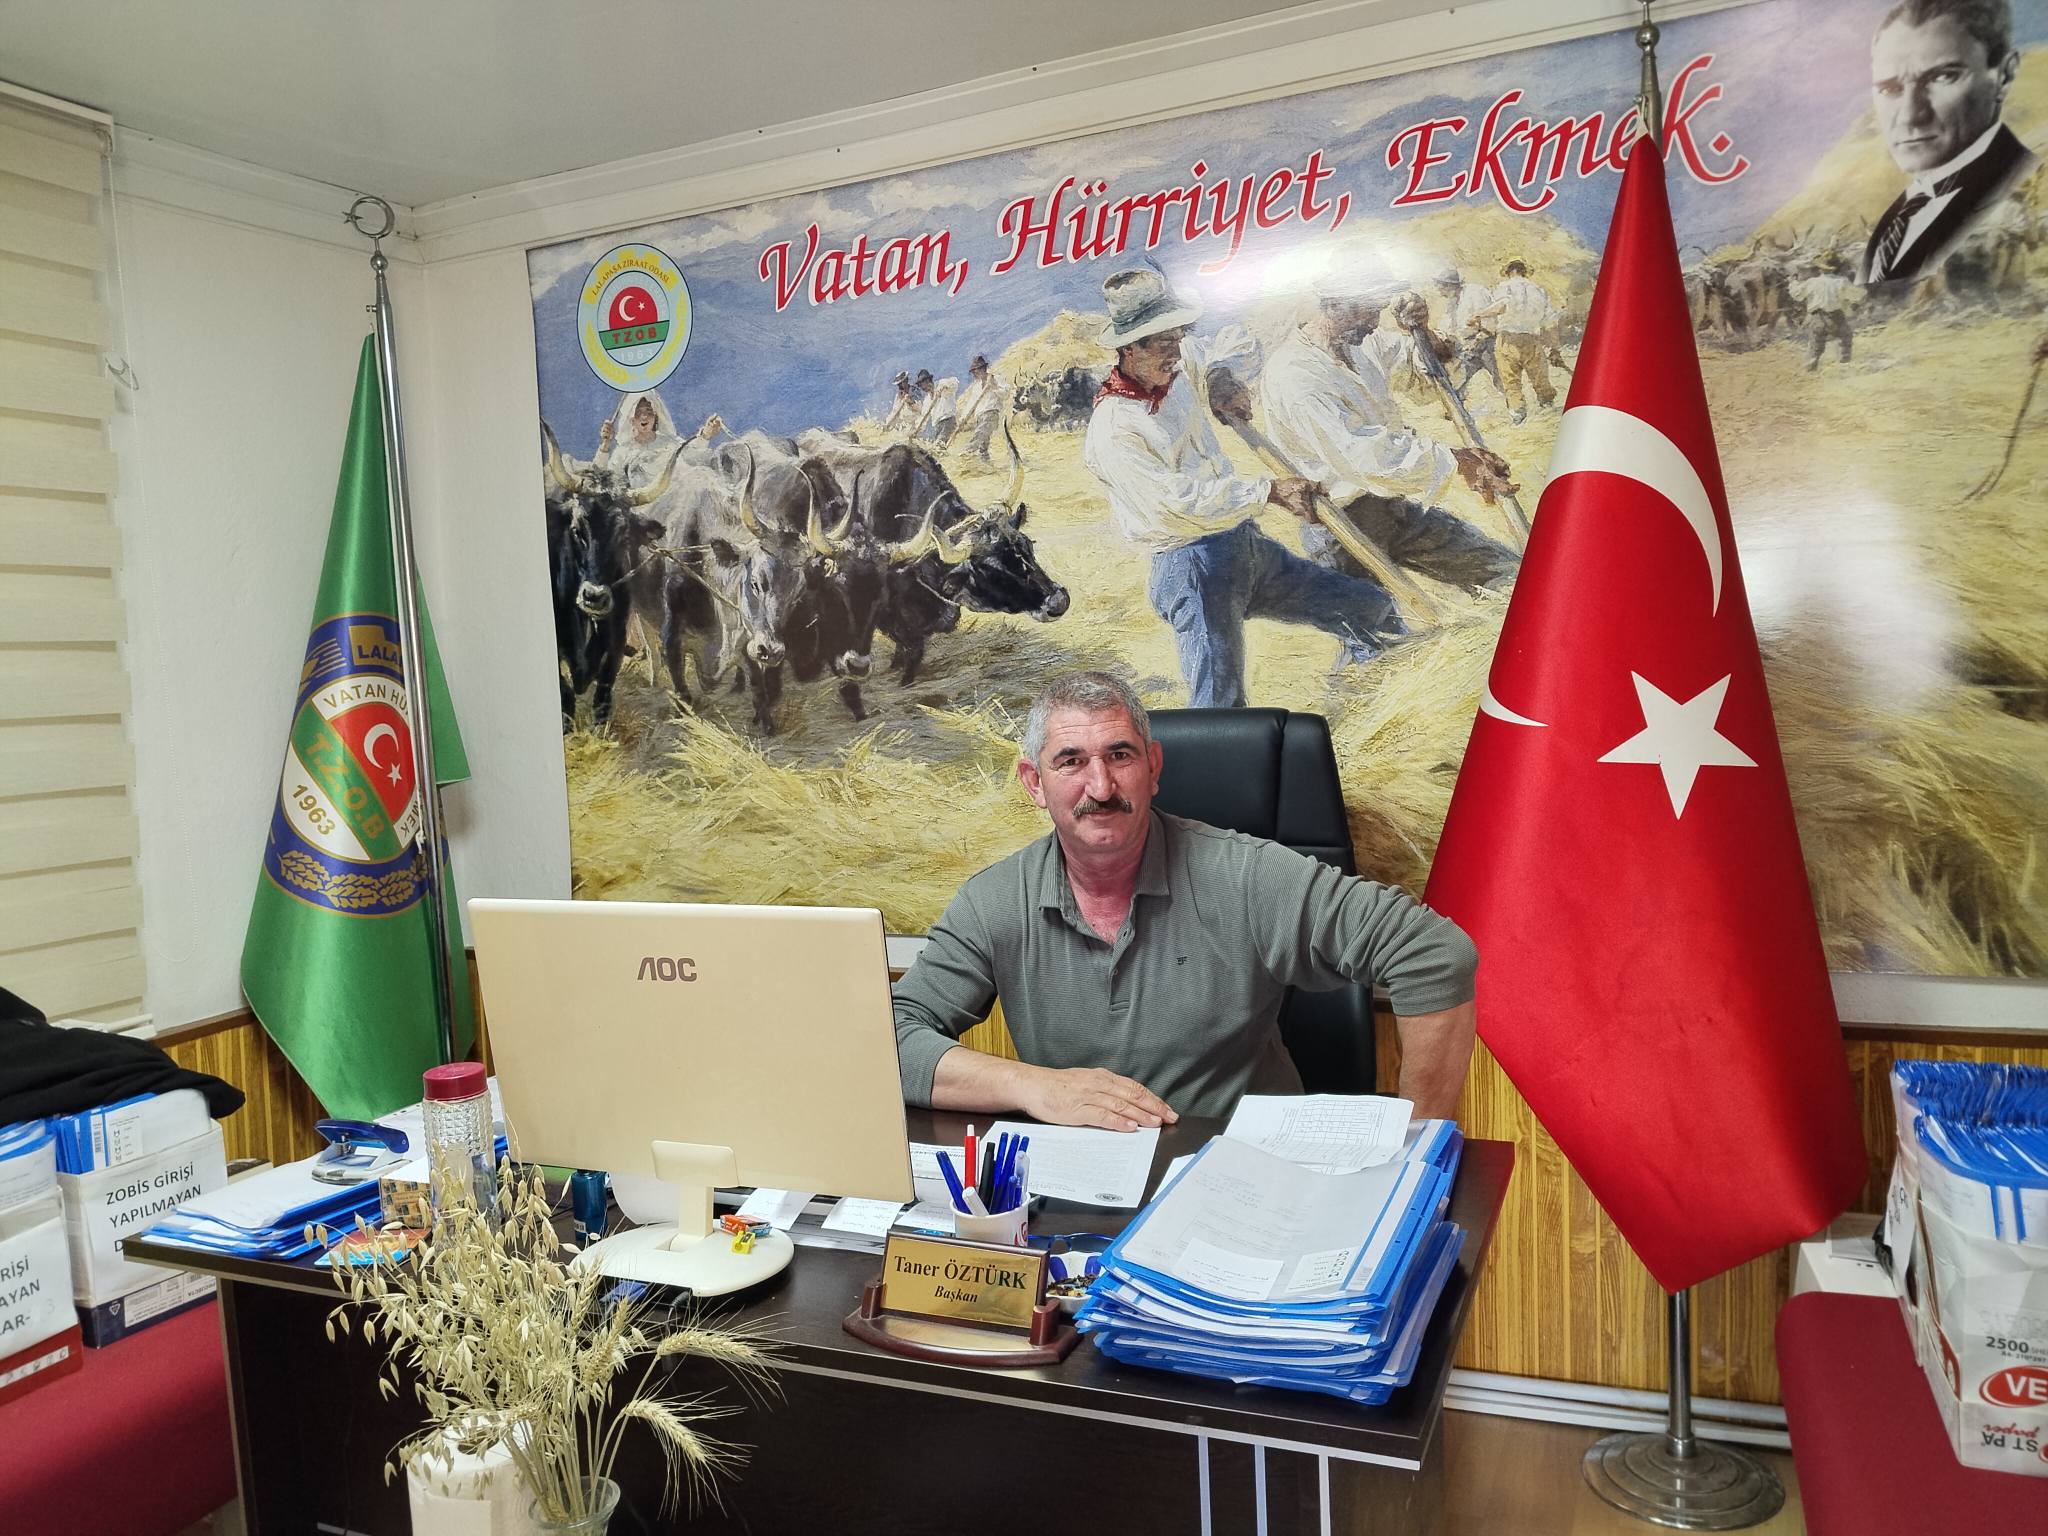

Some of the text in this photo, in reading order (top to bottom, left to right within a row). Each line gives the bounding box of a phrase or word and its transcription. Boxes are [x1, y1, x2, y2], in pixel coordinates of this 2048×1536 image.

[759, 221, 969, 312] Vatan,
[989, 148, 1352, 276] Hürriyet,
[1384, 53, 1751, 213] Ekmek.
[612, 326, 657, 344] TZOB
[357, 644, 400, 664] LALA
[323, 683, 387, 709] VATAN
[292, 784, 336, 836] 1963
[637, 957, 698, 982] AOC
[105, 1161, 194, 1205] ZOBİS GİRİŞİ
[109, 1184, 202, 1229] YAPILMAYAN
[894, 1255, 1028, 1290] Taner ÖZTÜRK
[934, 1285, 979, 1303] Başkan
[0, 1313, 31, 1336] AR-
[1985, 1335, 2030, 1354] 2500
[2005, 1372, 2048, 1402] VE
